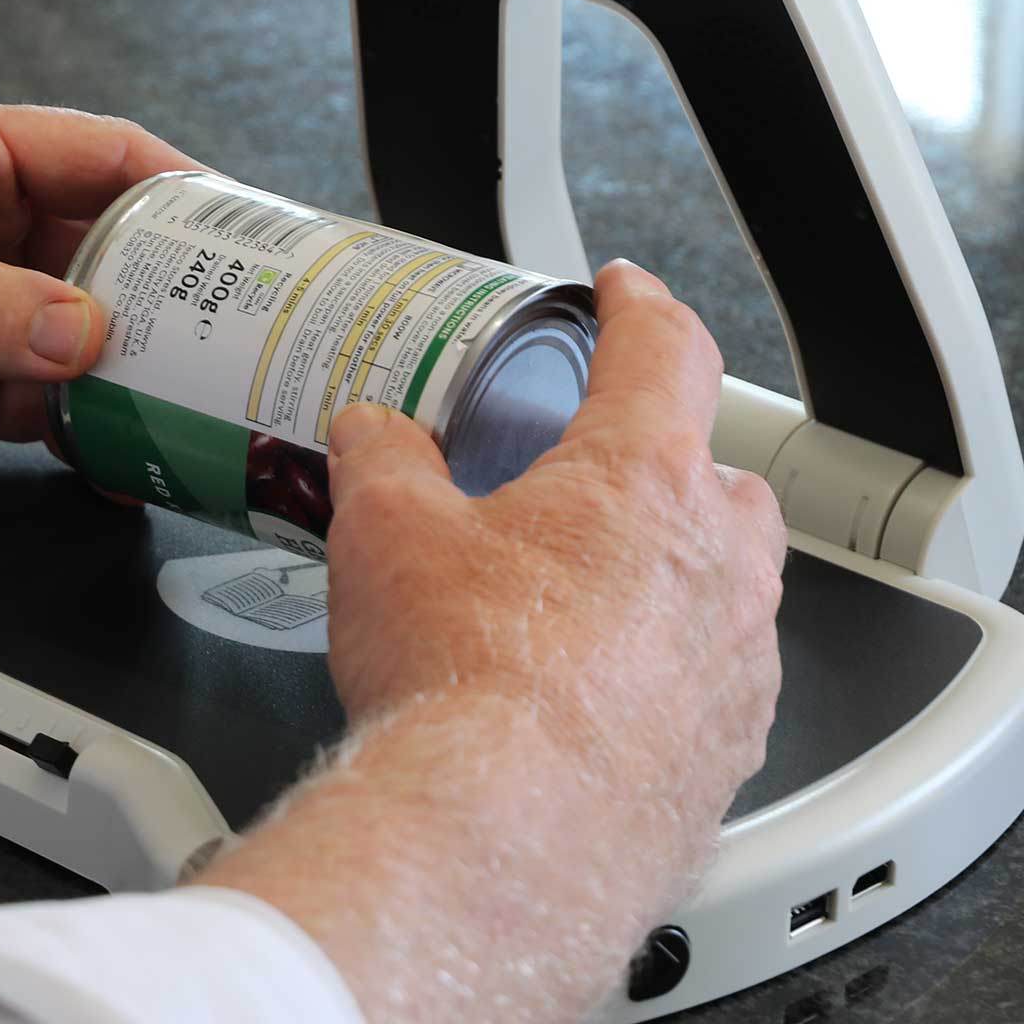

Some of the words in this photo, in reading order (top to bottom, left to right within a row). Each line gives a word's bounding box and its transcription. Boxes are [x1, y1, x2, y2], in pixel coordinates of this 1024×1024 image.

[127, 239, 145, 260] Tesco
[146, 233, 161, 247] Dun
[158, 239, 177, 259] Tesco
[163, 240, 187, 268] Garden
[175, 244, 195, 264] Tesco
[131, 262, 151, 291] Marine
[142, 260, 163, 289] Ireland
[153, 269, 167, 286] City
[160, 266, 179, 293] Stores
[171, 248, 214, 300] 240g
[201, 259, 243, 313] 400g
[232, 275, 250, 299] Weight
[242, 283, 263, 309] Recycle
[260, 272, 292, 312] Recycling
[282, 292, 299, 314] mins
[388, 290, 402, 302] full
[356, 309, 370, 326] min
[370, 302, 390, 327] power
[437, 288, 487, 340] INSTRUCTIONS
[119, 314, 137, 355] Gresham
[140, 318, 155, 352] Welwyn
[361, 330, 374, 343] for
[282, 355, 299, 387] before
[344, 345, 364, 383] another
[322, 391, 332, 410] min
[145, 461, 171, 499] RED
